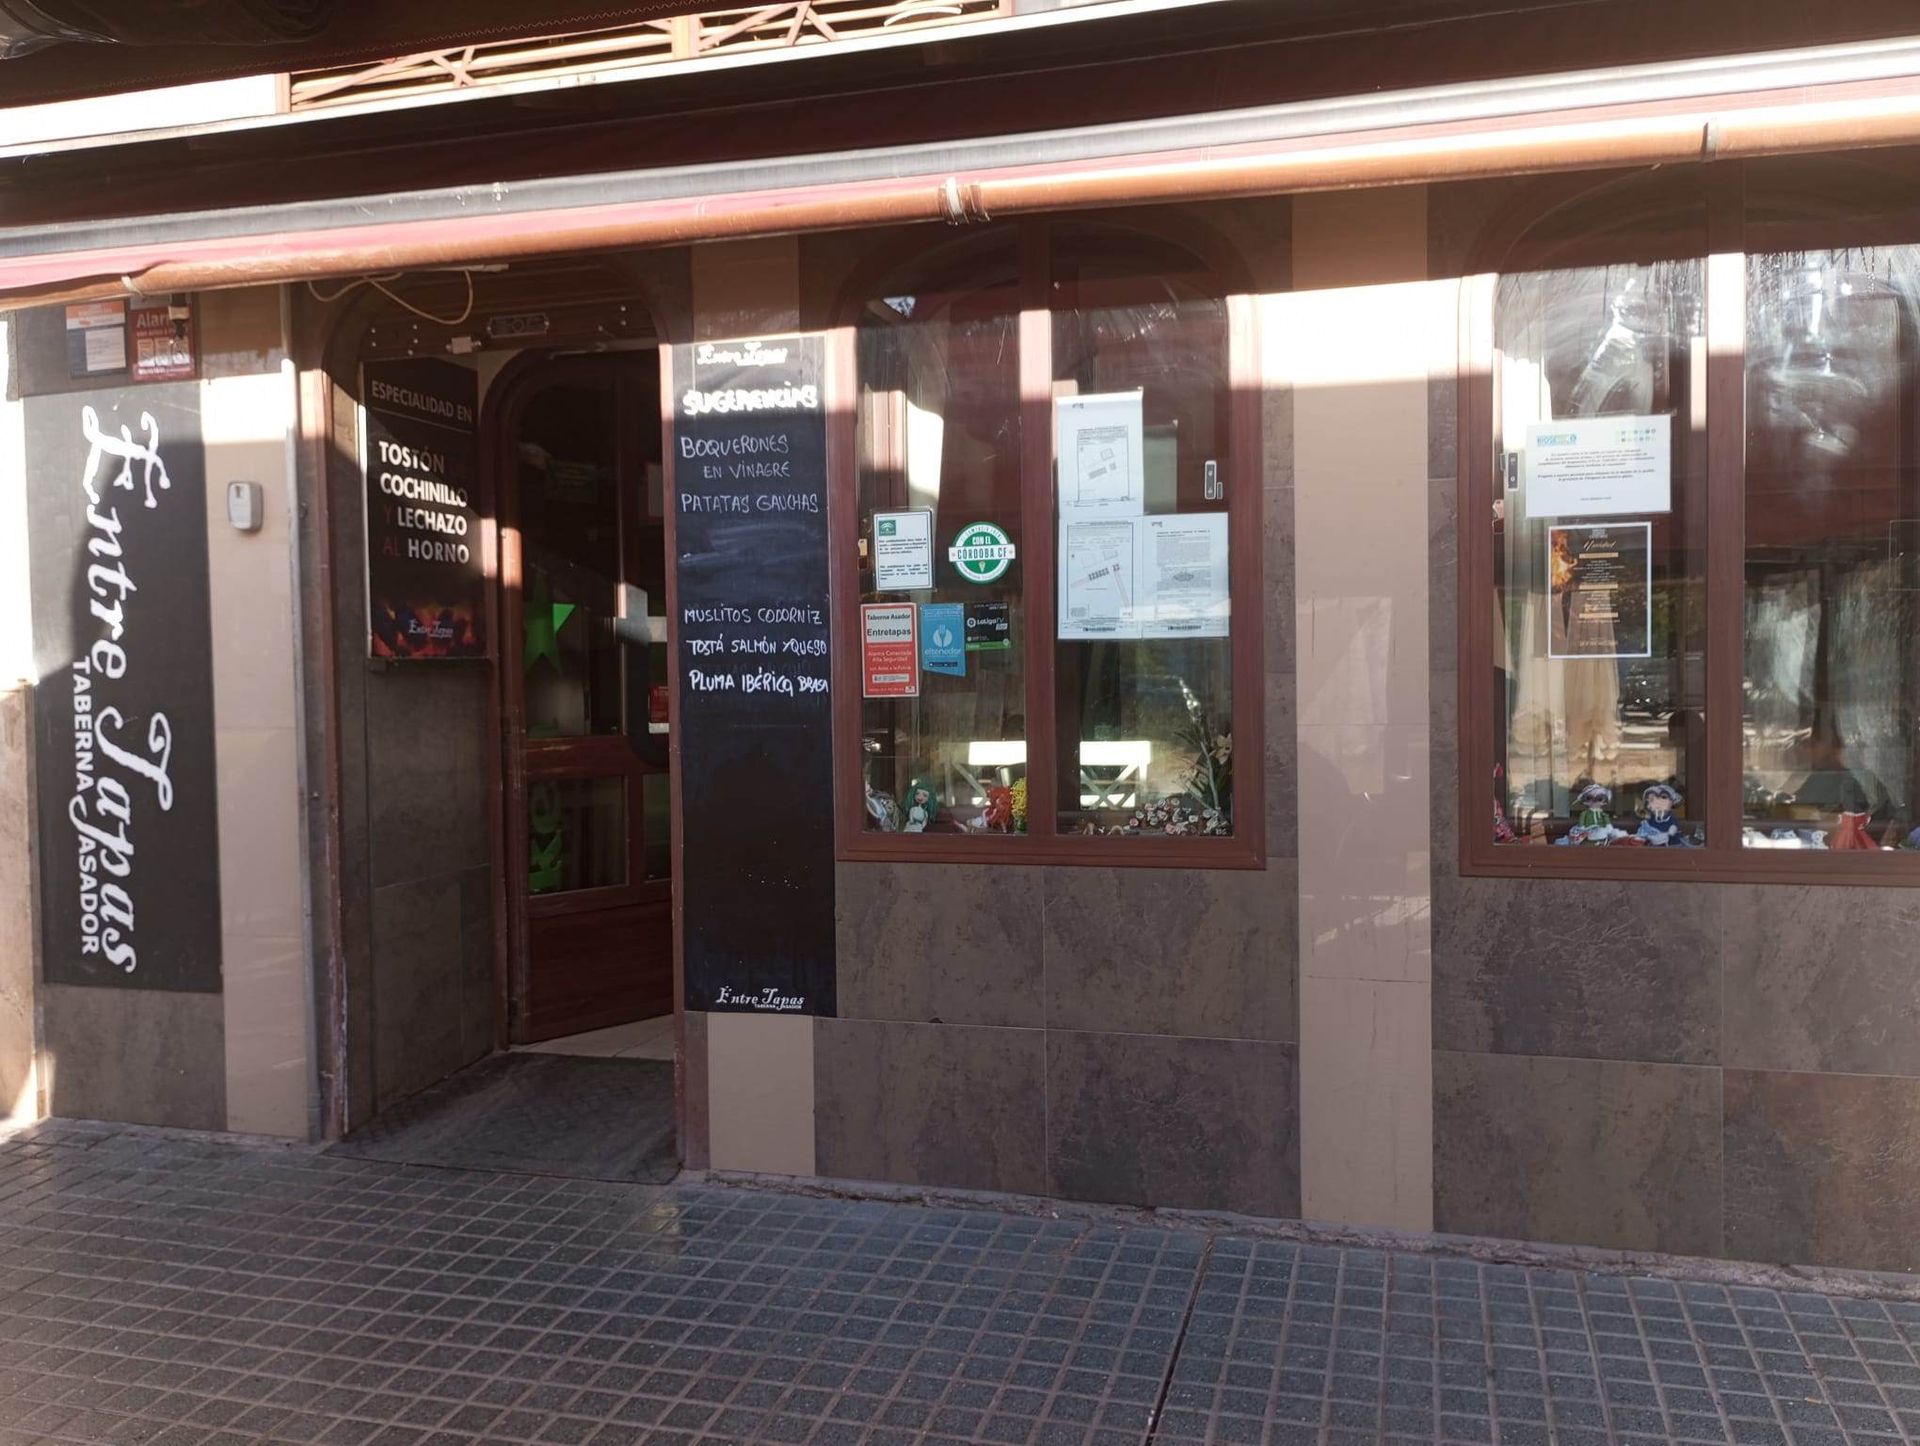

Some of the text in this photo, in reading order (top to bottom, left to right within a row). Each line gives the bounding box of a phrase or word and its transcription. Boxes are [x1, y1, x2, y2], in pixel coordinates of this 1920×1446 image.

[371, 380, 473, 423] ESPECIALIDAD EN
[378, 440, 445, 474] TOSTÓN
[681, 434, 789, 459] BOQUERONES
[703, 460, 792, 479] EN VINAGRE
[380, 472, 468, 508] COCHINILLO
[681, 492, 819, 514] PATATAS GAUCHAS
[397, 505, 468, 536] LECHAZO
[82, 404, 172, 680] Entre
[382, 538, 470, 564] AL HORNO
[997, 547, 1007, 558] CF
[684, 603, 823, 625] MUSLITOS CODORNIZ
[731, 636, 777, 654] SALMÓN
[866, 628, 911, 637] Entretapas
[688, 669, 735, 691] PLUMA
[796, 674, 829, 693] BRASA
[72, 656, 100, 955] TABERNA ASADOR
[68, 705, 174, 974] Tapas
[715, 985, 805, 1010] Entre Tapas
